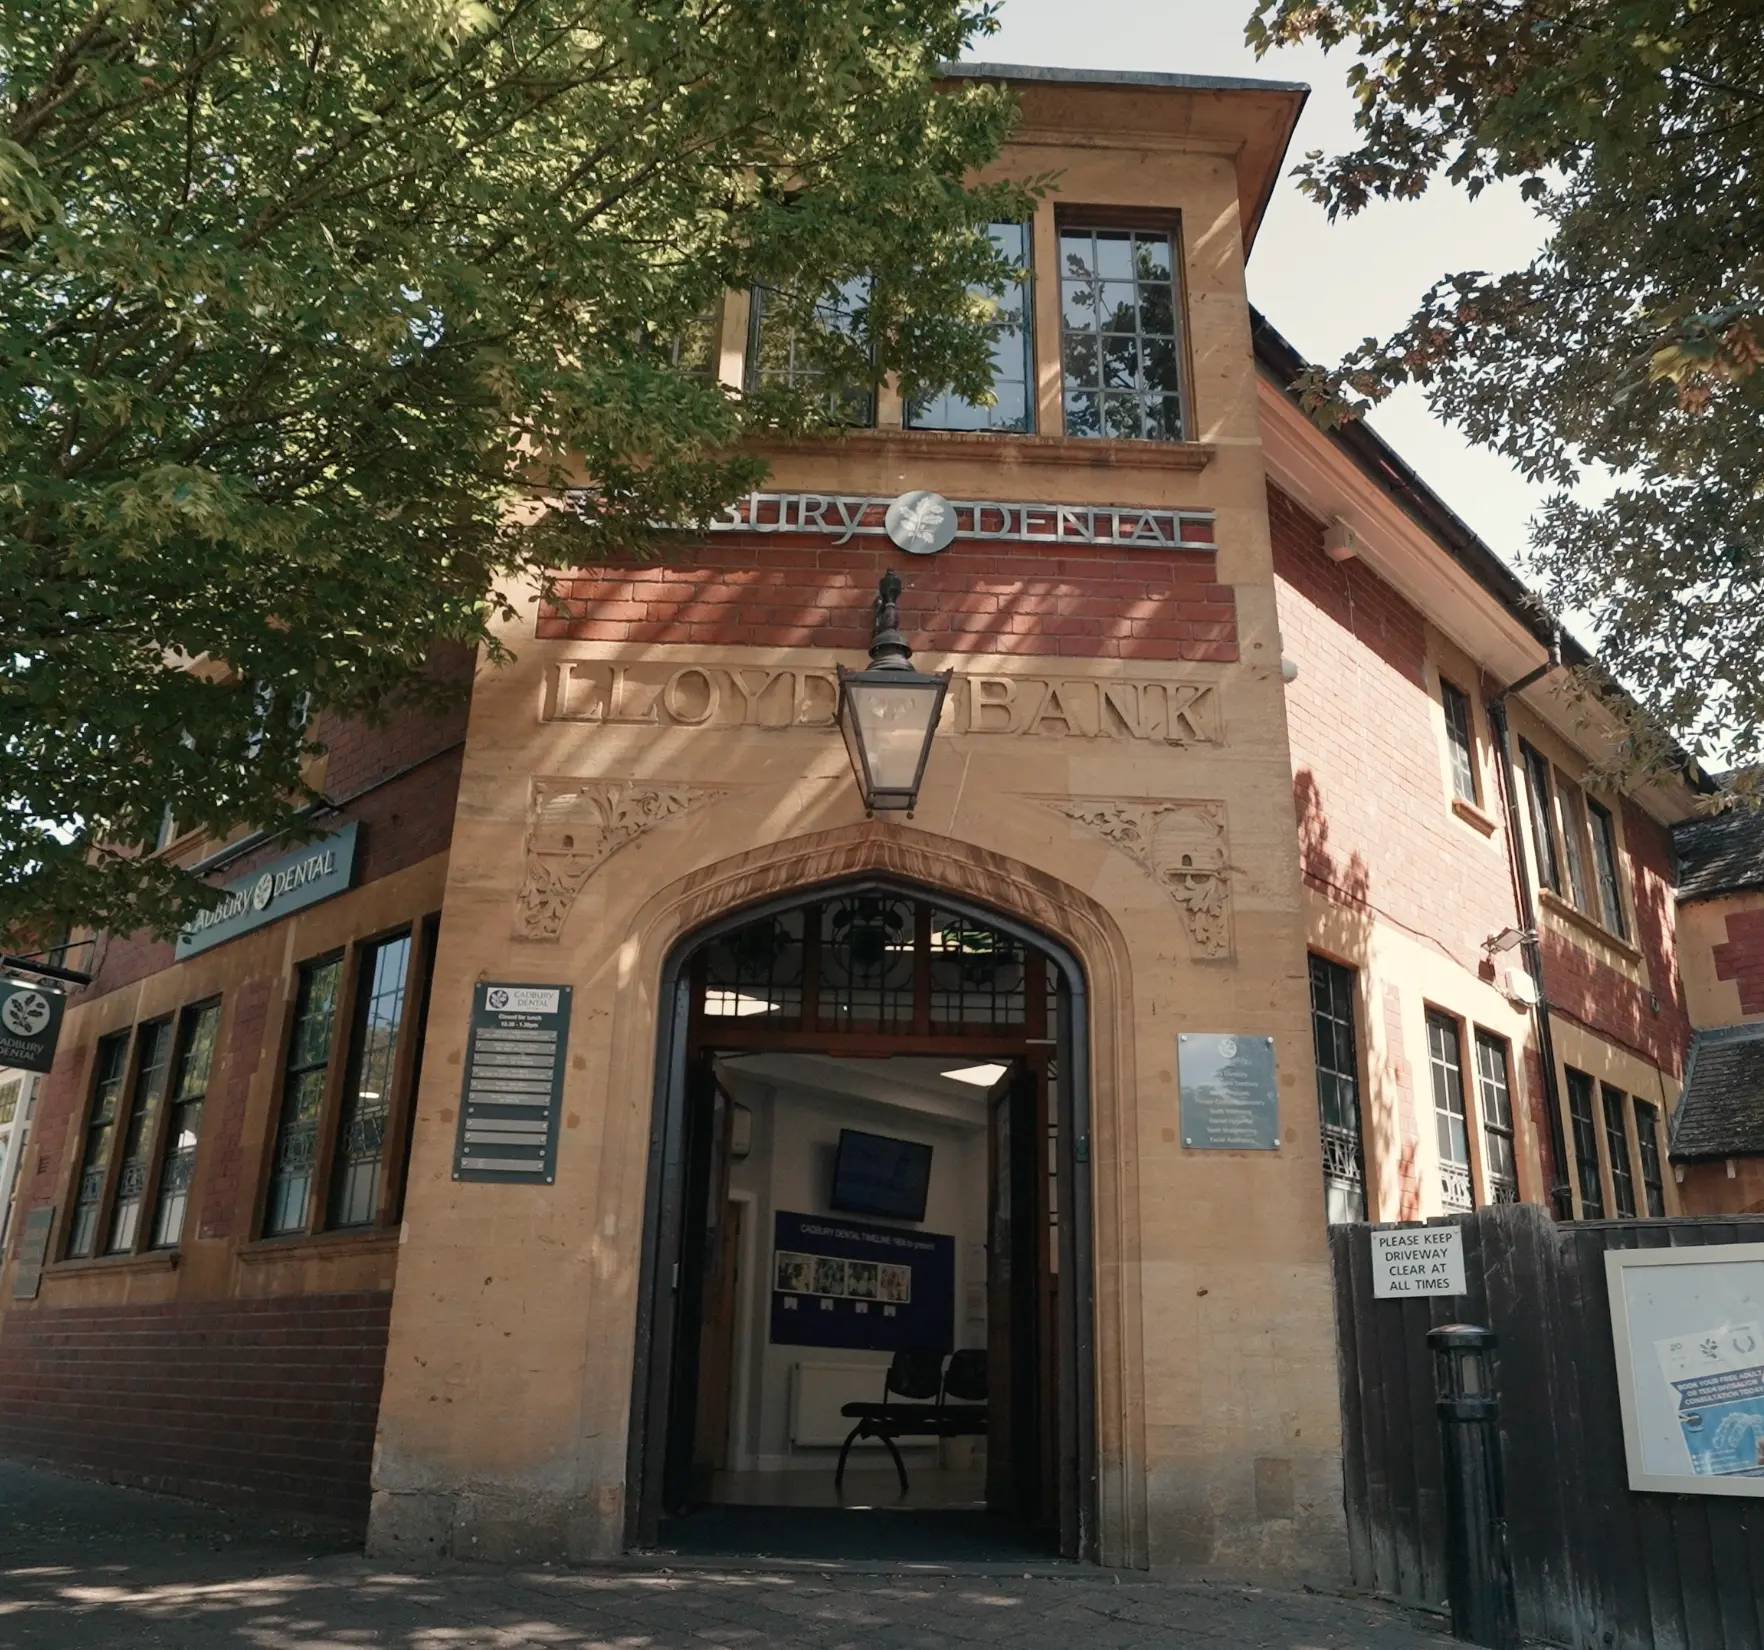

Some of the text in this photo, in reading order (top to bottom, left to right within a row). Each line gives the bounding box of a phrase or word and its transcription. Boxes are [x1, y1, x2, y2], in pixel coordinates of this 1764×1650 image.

[972, 501, 1192, 549] DENTAL
[552, 661, 1216, 742] LLOYD BANK
[181, 849, 334, 933] ADBURY DENTAL
[513, 990, 555, 1000] CADBURY
[517, 999, 548, 1008] DENTAL
[0, 1037, 45, 1057] ADBURY
[800, 1223, 834, 1236] CADBURY
[834, 1228, 860, 1241] DENTAL
[861, 1231, 892, 1245] TIMELINE
[1379, 1232, 1452, 1247] PLEASE KEEP
[1385, 1248, 1448, 1262] DRIVEWAY
[1389, 1263, 1447, 1276] CLEAR AT
[1389, 1278, 1450, 1291] ALL TIMES
[1677, 1370, 1762, 1391] BOOK YOUR FREE ADULT
[1684, 1391, 1739, 1405] CONSULTATION
[1687, 1389, 1698, 1397] OR
[1698, 1385, 1717, 1394] TEEN
